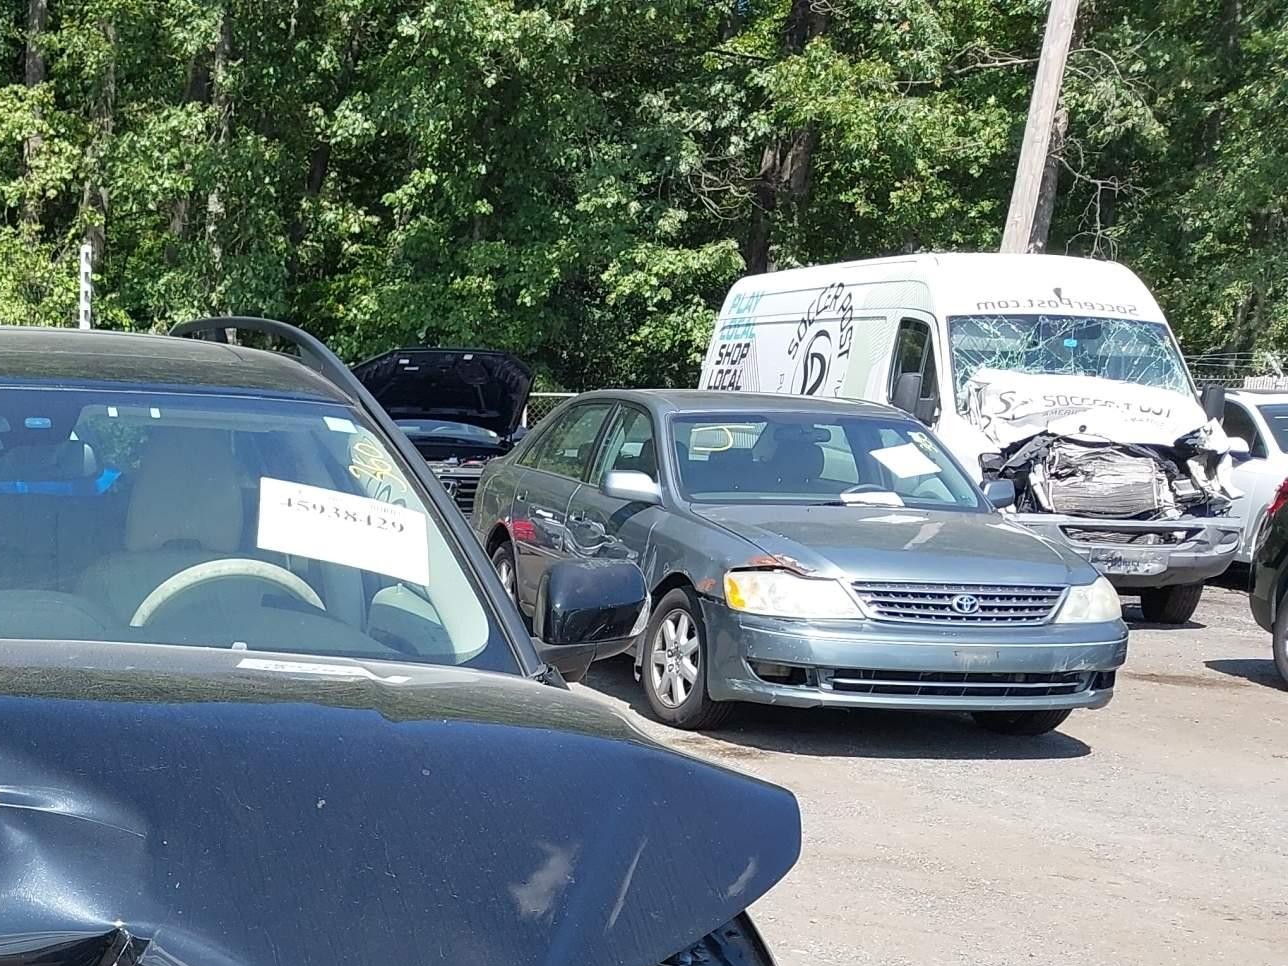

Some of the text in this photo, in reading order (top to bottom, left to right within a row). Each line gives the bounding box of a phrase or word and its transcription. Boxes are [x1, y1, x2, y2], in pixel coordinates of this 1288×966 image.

[727, 291, 765, 315] PLAY
[718, 318, 758, 340] LOCAL
[714, 342, 751, 365] SHOP
[707, 368, 744, 391] LOCAL
